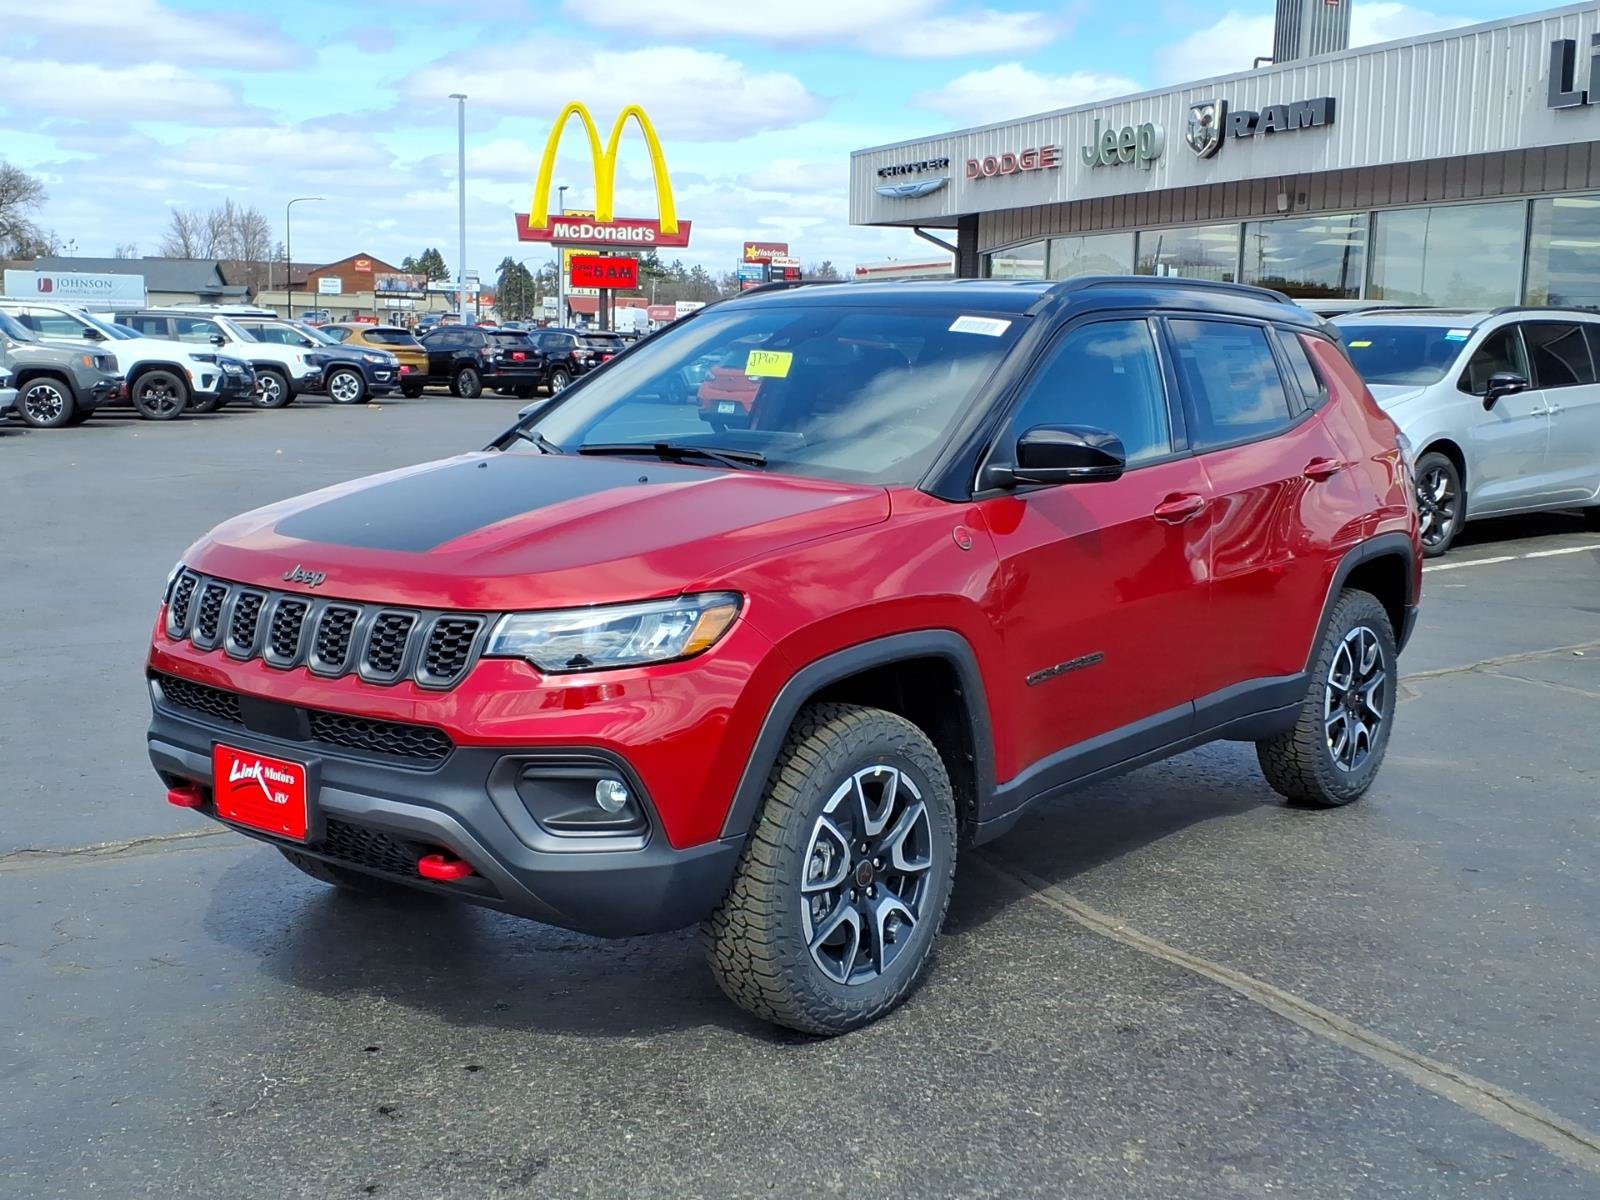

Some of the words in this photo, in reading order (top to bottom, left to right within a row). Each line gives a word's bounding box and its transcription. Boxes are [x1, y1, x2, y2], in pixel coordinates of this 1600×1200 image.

[1226, 97, 1335, 137] RAM
[1081, 118, 1158, 171] Jeep
[877, 158, 950, 178] CHRYSLER
[965, 145, 1060, 179] DODGE
[552, 223, 656, 241] McDonald's
[56, 278, 112, 289] JOHNSON
[282, 563, 327, 588] Jeep
[264, 766, 295, 785] Motors
[274, 792, 289, 804] RV
